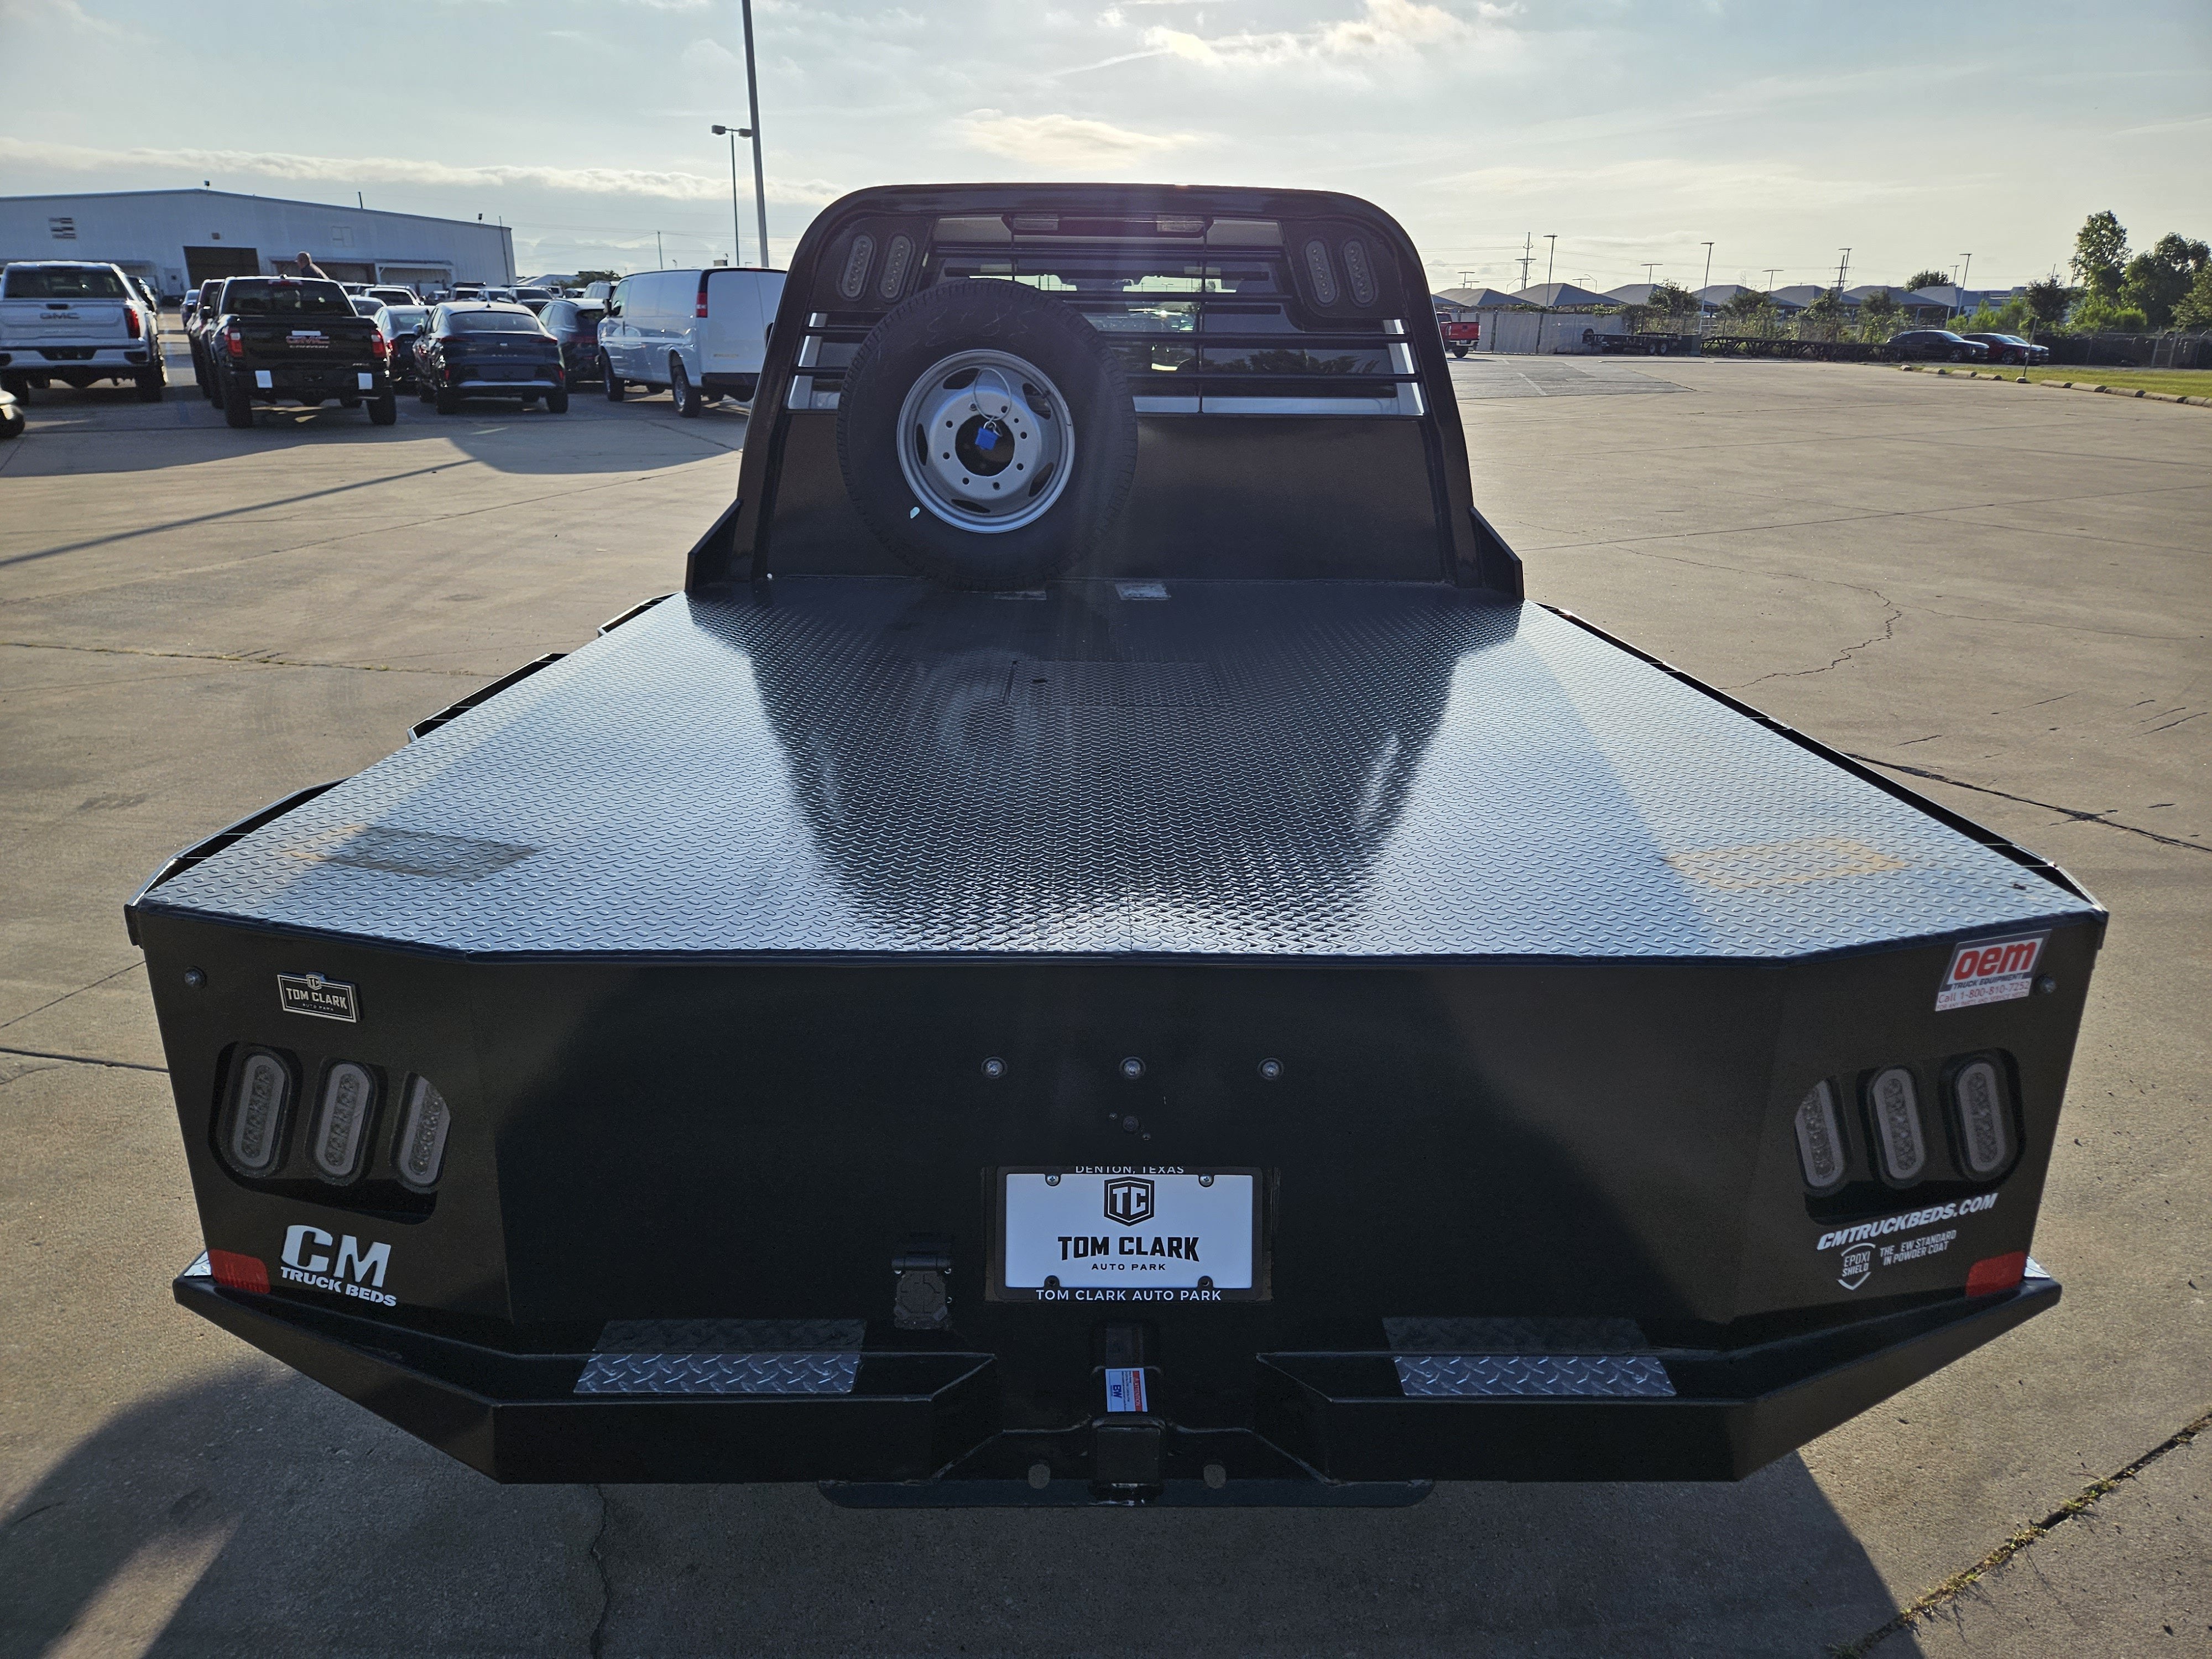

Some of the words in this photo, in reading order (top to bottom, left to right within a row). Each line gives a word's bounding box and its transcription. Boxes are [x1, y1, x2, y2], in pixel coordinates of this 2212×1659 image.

[1954, 942, 2037, 980] oem
[1954, 979, 1979, 989] TRUCK
[1979, 973, 2023, 985] EQUIPMENT
[286, 988, 309, 1000] TOM
[311, 992, 347, 1009] CLARK
[1939, 992, 1956, 1003] Call
[1113, 1186, 1146, 1214] TC
[1817, 1193, 1998, 1250] CMTRUCKBEDS.COM
[1058, 1237, 1109, 1260] TOM
[1119, 1237, 1199, 1261] CLARK
[1880, 1245, 1895, 1257] THE
[1916, 1230, 1957, 1248] STANDARD
[1884, 1256, 1892, 1266] IN
[1893, 1246, 1927, 1264] POWDER
[1928, 1241, 1949, 1254] COAT
[281, 1225, 391, 1287] CM
[1844, 1251, 1870, 1267] EPOXI
[1842, 1262, 1869, 1277] SHIELD
[280, 1266, 342, 1293] TRUCK
[345, 1284, 397, 1306] BEDS
[1036, 1290, 1069, 1300] TOM
[1076, 1290, 1126, 1301] CLARK
[1132, 1290, 1173, 1301] AUTO
[1180, 1290, 1222, 1301] PARK
